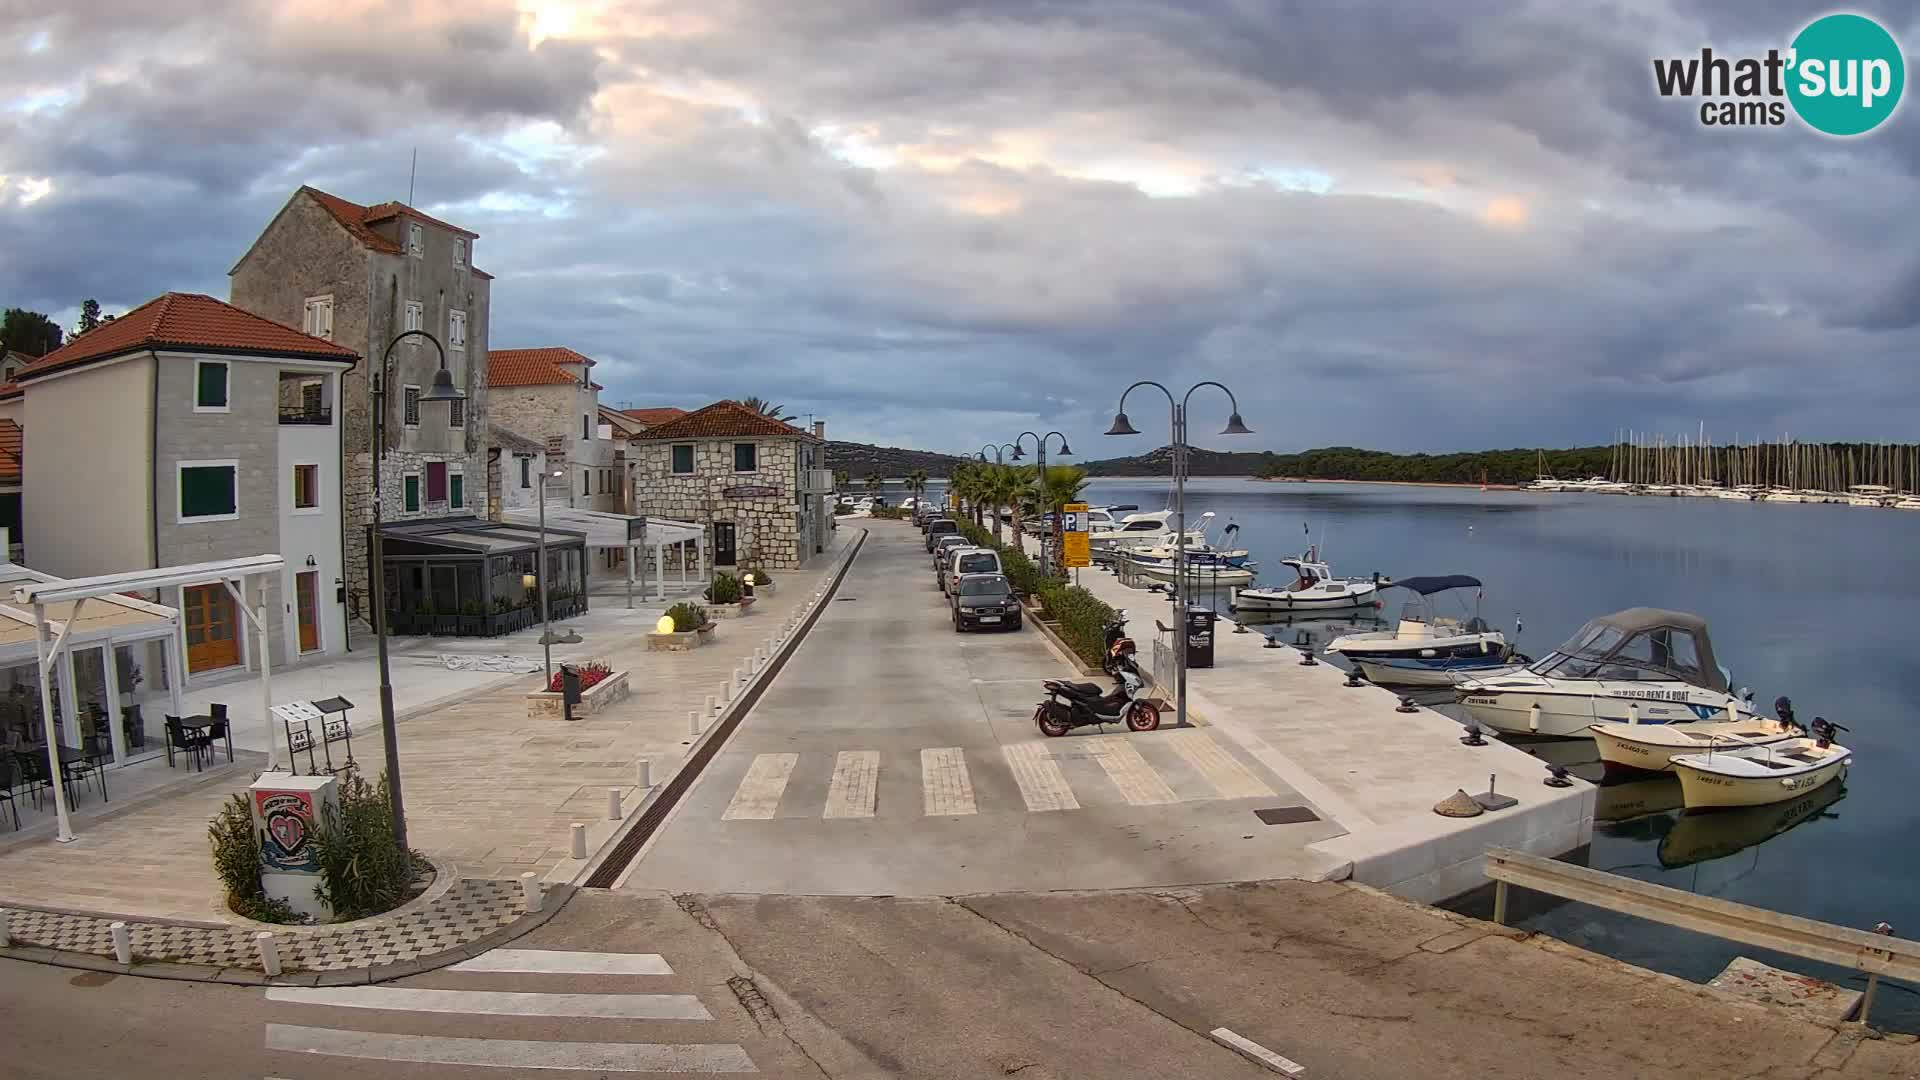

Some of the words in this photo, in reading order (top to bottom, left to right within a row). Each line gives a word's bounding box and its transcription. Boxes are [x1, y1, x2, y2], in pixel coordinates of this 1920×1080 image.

[1646, 691, 1664, 700] RENT
[1666, 691, 1671, 700] A
[1672, 691, 1690, 702] BOAT
